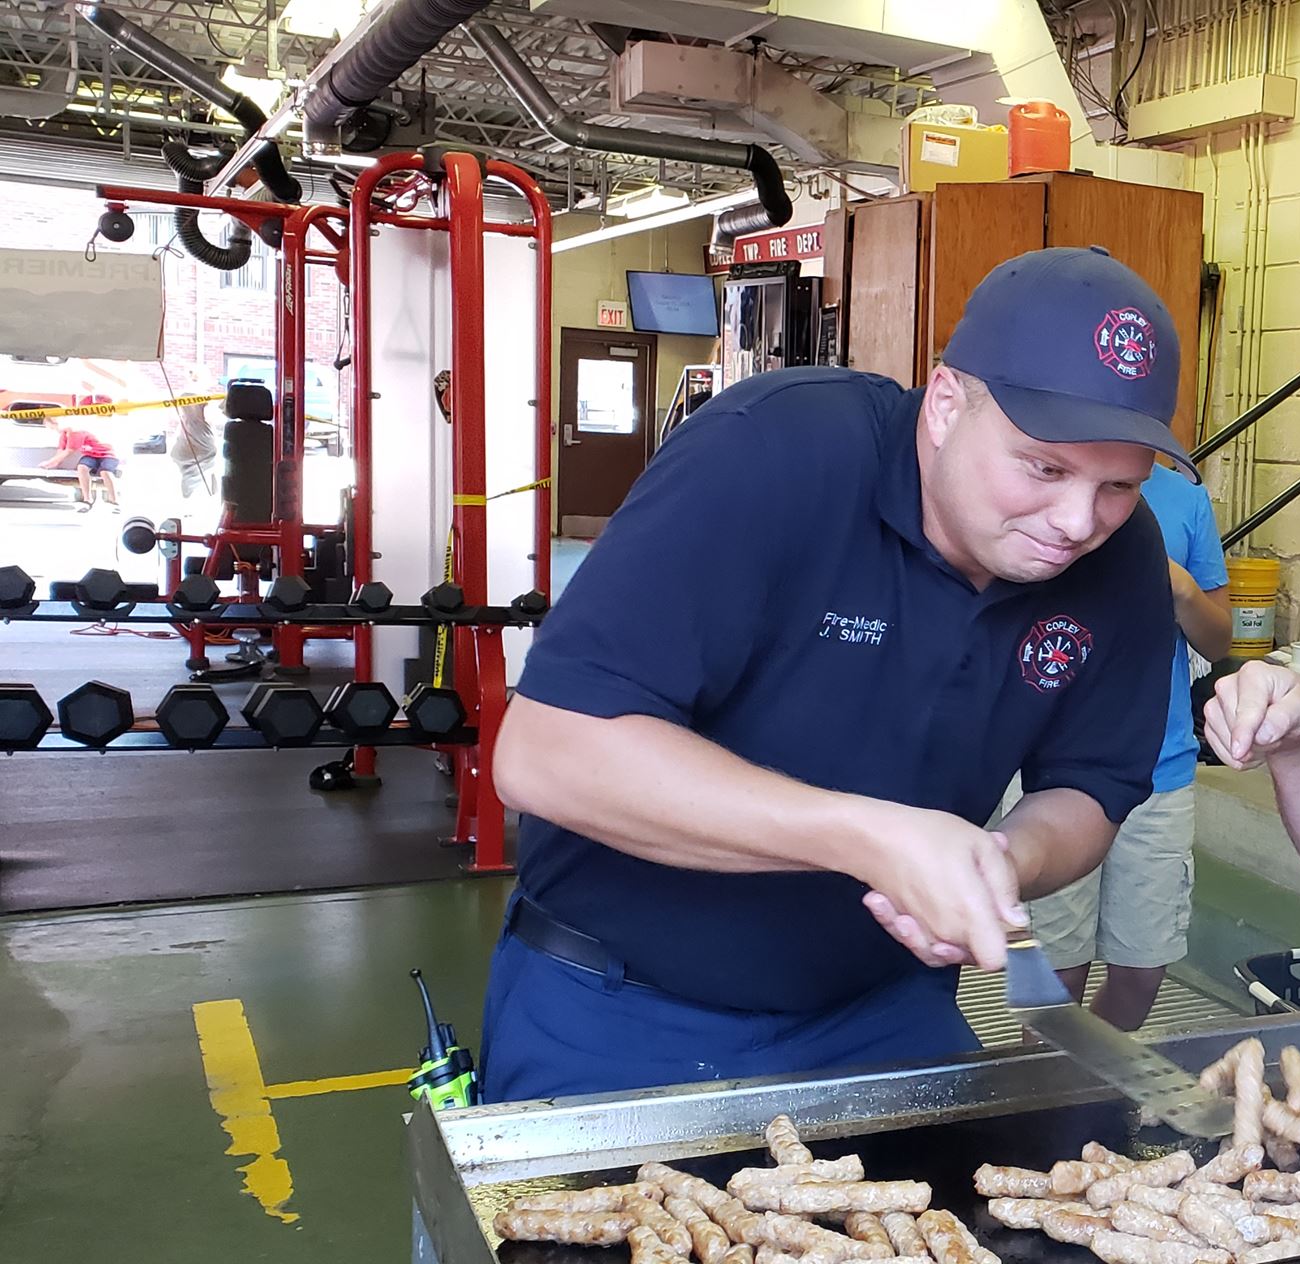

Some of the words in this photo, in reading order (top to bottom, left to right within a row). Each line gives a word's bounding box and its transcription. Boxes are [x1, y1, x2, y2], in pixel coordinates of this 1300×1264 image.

[743, 243, 762, 262] TWP.
[770, 238, 787, 257] FIRE
[797, 232, 820, 254] DEPT.
[601, 308, 624, 325] EXIT
[1119, 312, 1147, 327] COPLEY
[1117, 363, 1137, 376] FIRE
[823, 612, 887, 632] Fire-Medic
[1046, 621, 1080, 634] COPLEY
[819, 626, 830, 638] J.
[839, 628, 882, 645] SMITH
[1039, 679, 1060, 688] FIRE
